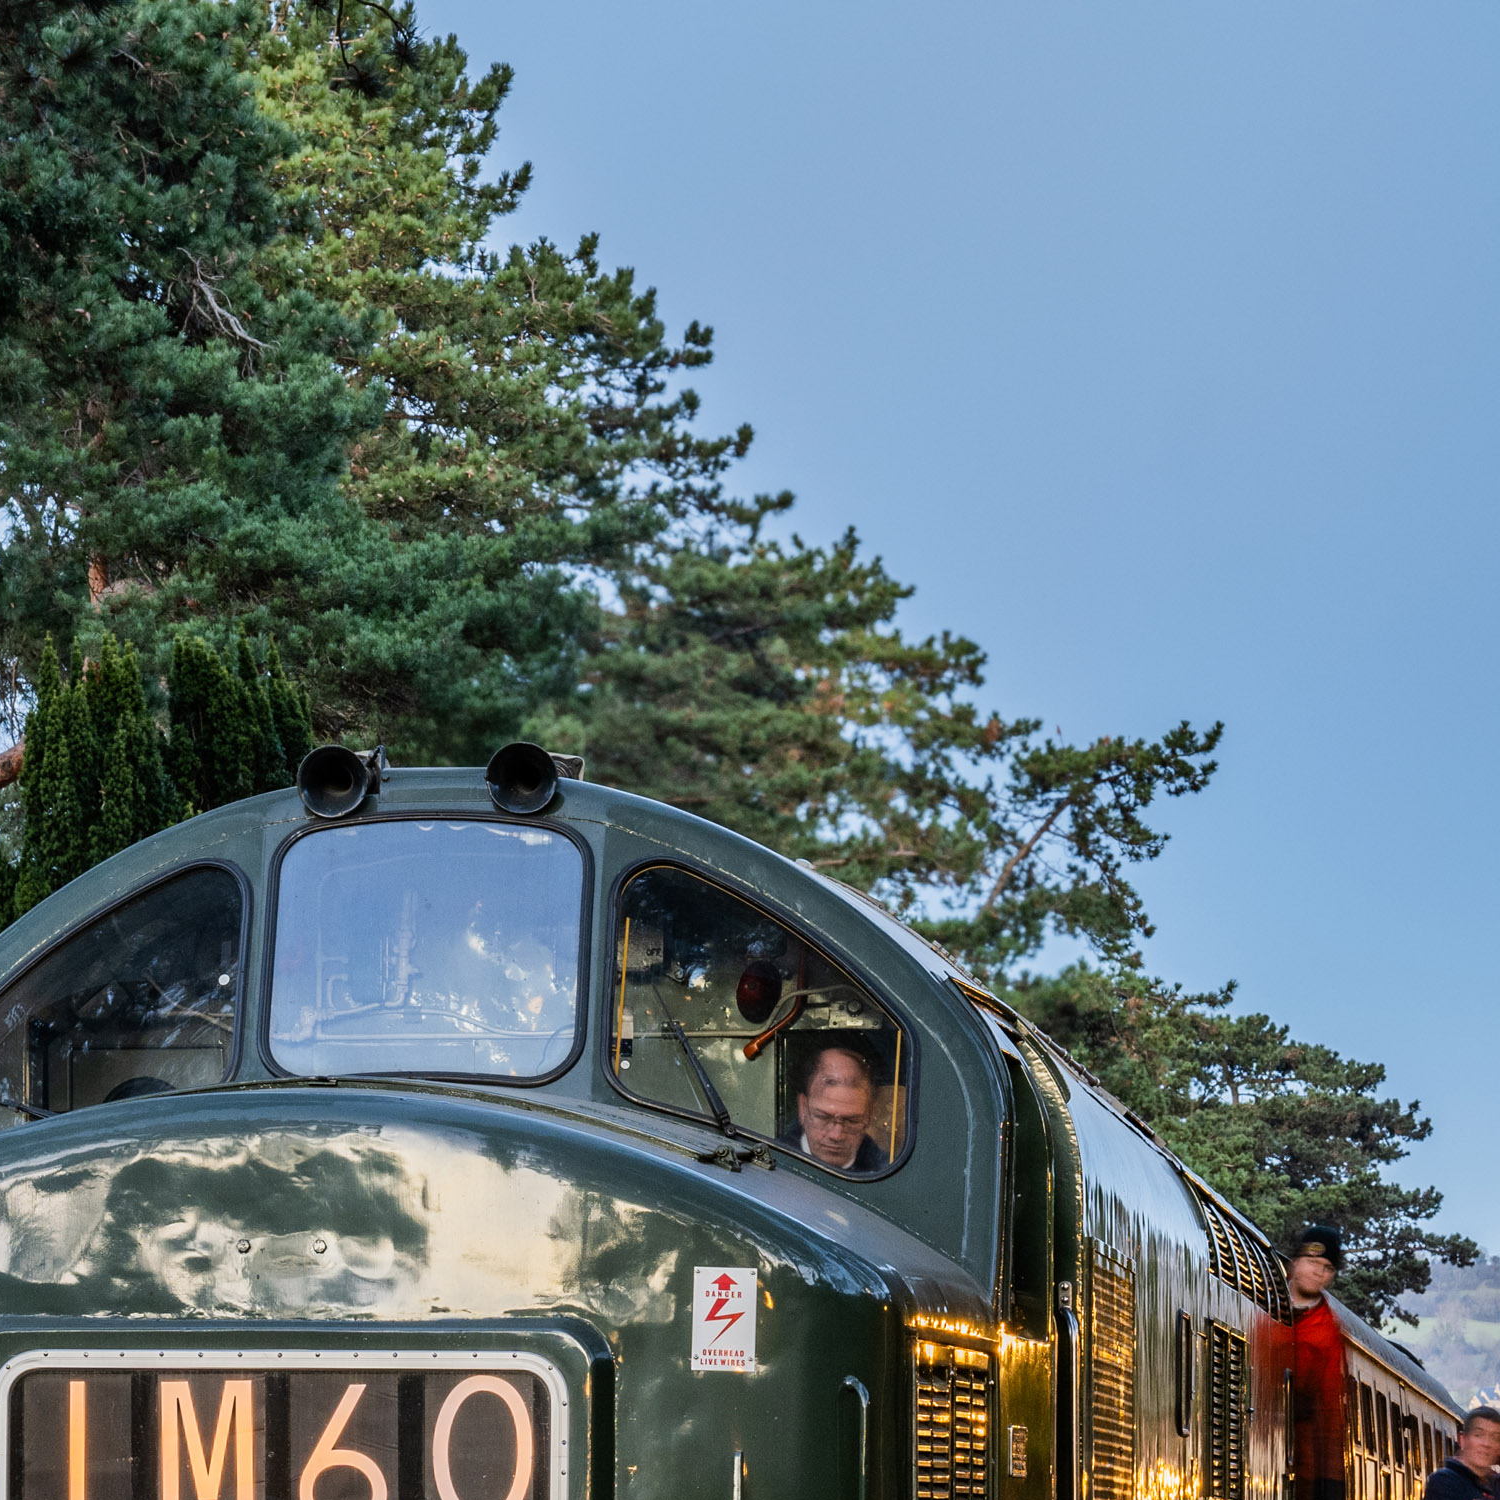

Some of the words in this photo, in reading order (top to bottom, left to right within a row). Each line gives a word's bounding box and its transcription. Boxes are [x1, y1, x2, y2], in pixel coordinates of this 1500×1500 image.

[705, 1290, 742, 1298] DANGER
[702, 1348, 745, 1357] OVERHEAD
[700, 1358, 718, 1366] LIVE
[720, 1358, 746, 1367] WIRES
